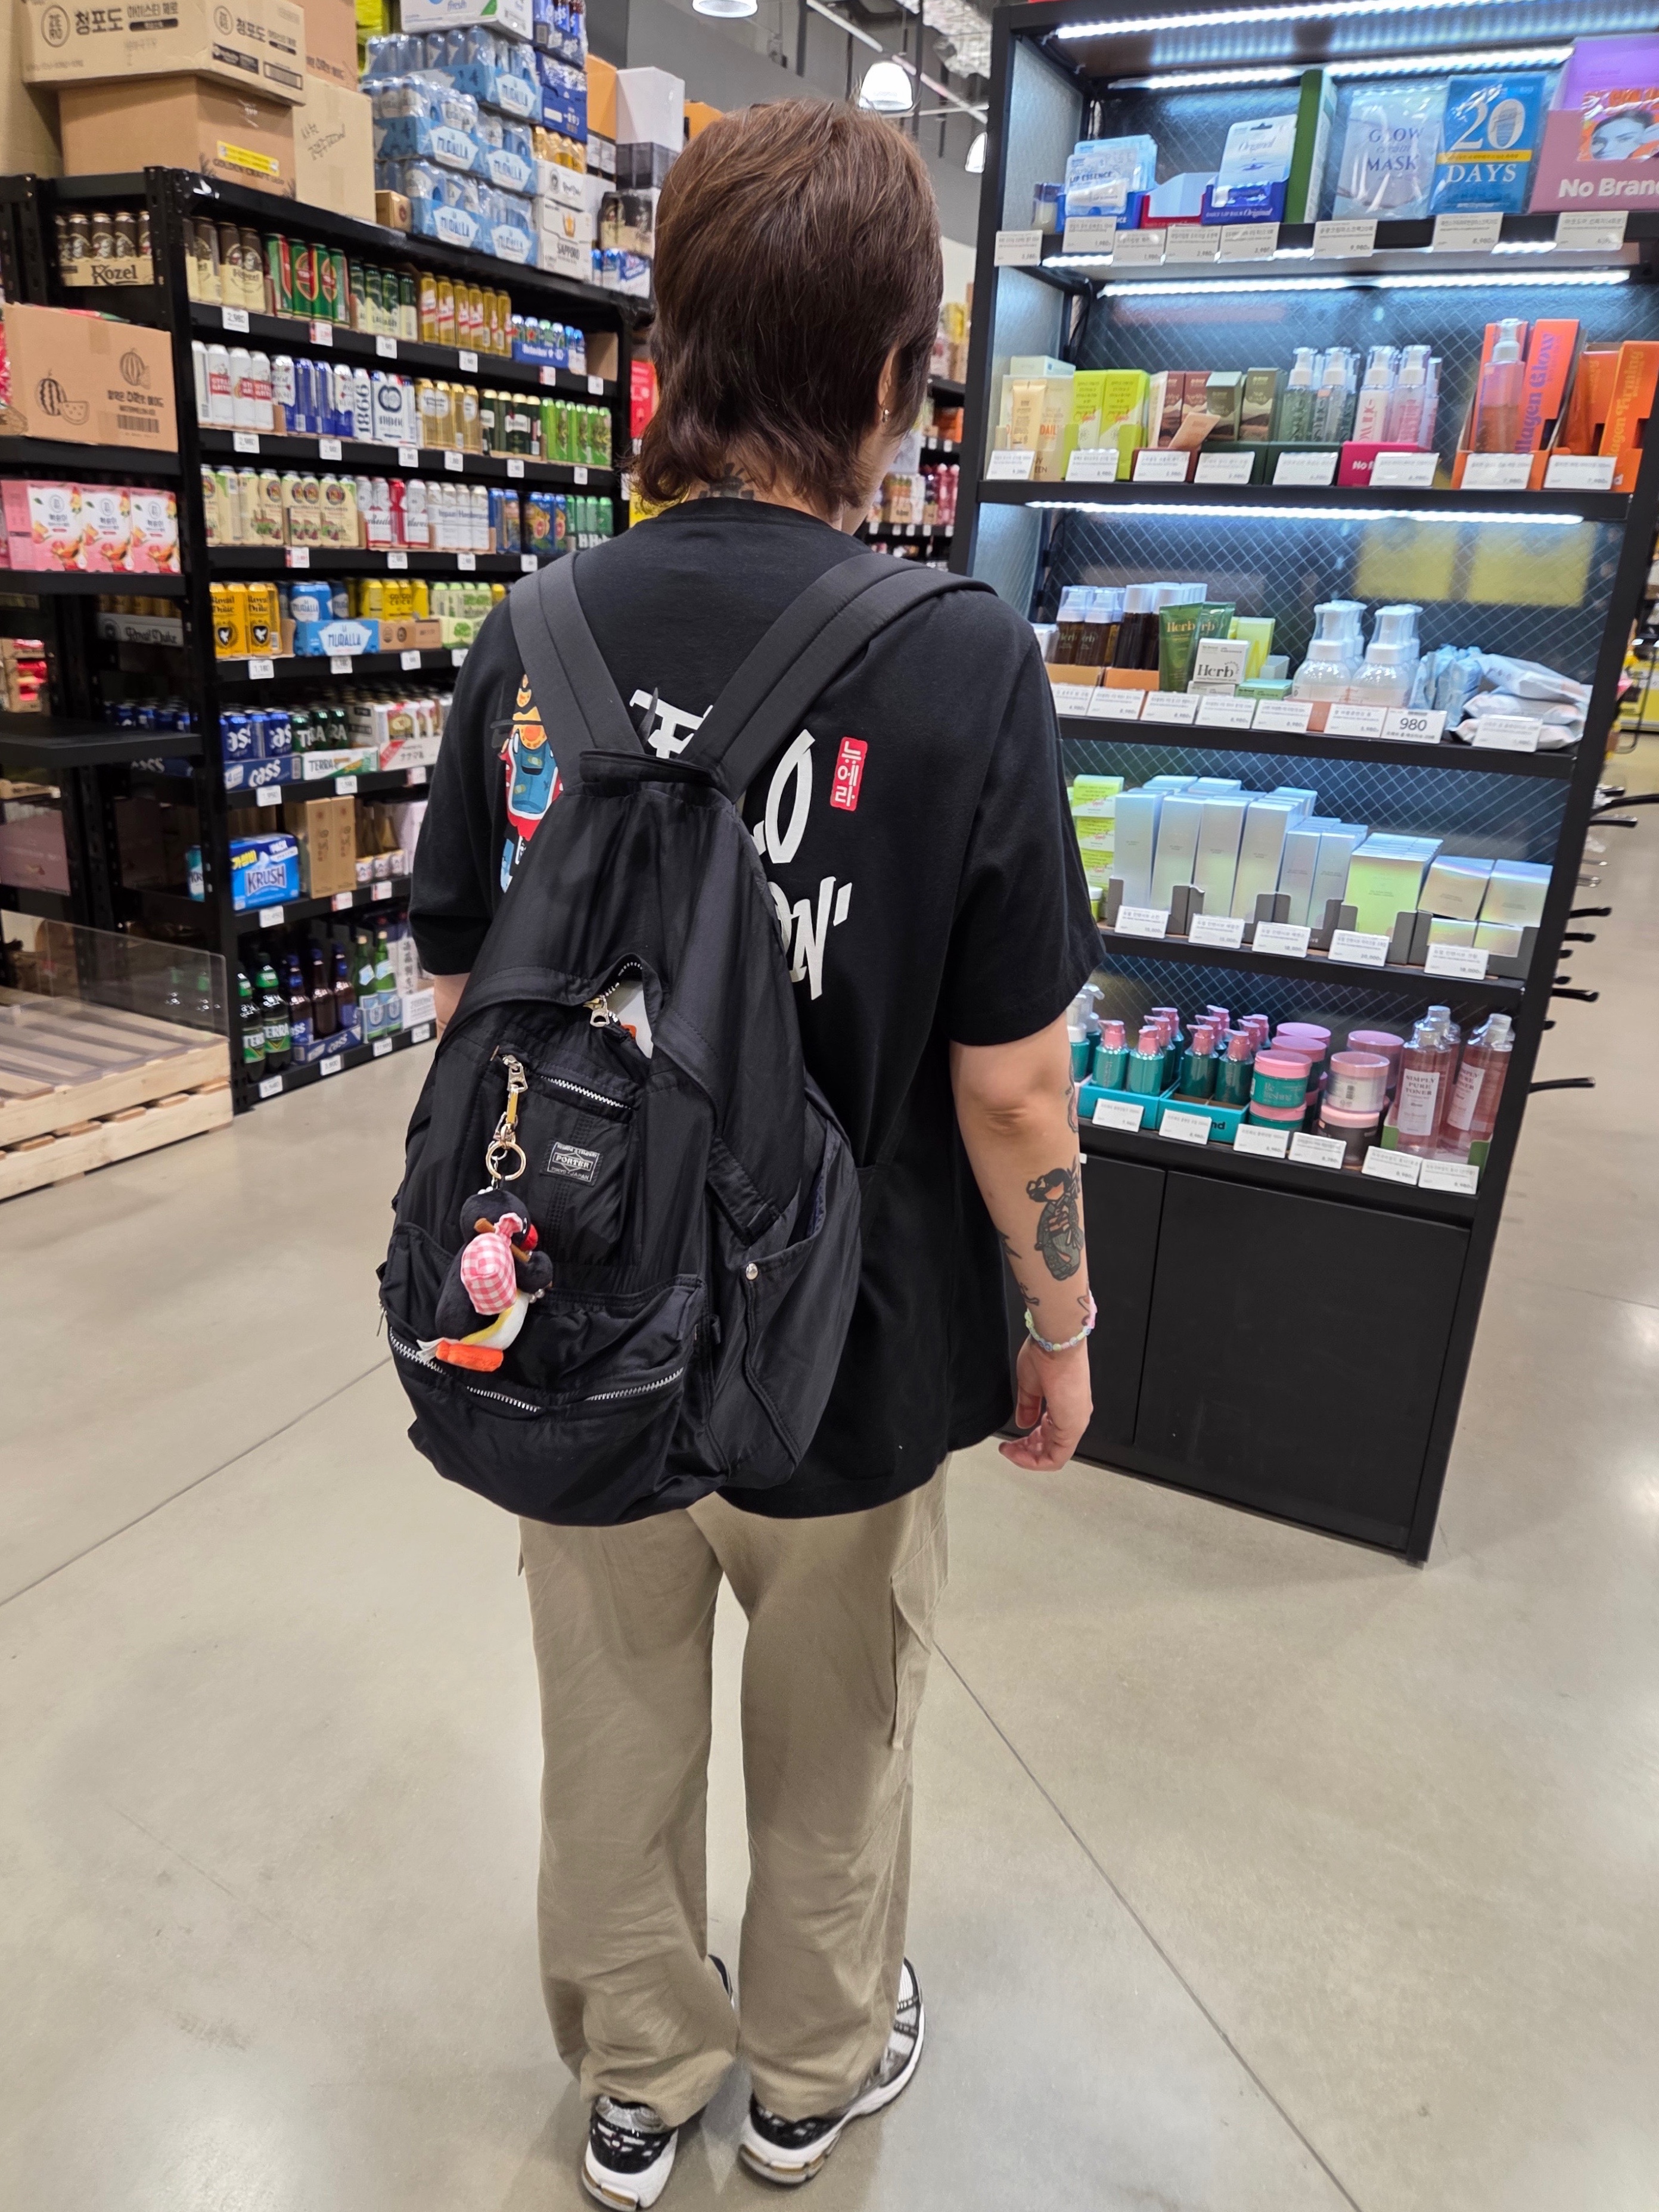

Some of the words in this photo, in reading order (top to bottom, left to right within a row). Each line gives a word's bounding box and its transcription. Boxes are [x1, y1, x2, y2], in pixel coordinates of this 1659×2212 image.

[74, 8, 123, 35] 청포도
[1447, 98, 1526, 150] 20
[1366, 155, 1419, 172] MASK
[1447, 164, 1517, 182] DAYS
[1558, 179, 1594, 197] No
[91, 265, 139, 286] Kozel
[1528, 333, 1555, 389] Glow
[1514, 391, 1543, 453] llagen
[1167, 620, 1195, 633] Herb
[328, 633, 361, 647] MURALLA
[1197, 663, 1234, 678] Herb
[1399, 717, 1428, 732] 980
[309, 759, 334, 772] TERRA
[835, 741, 862, 807] 뉴에라
[248, 866, 285, 893] KRUSH
[1406, 1074, 1436, 1084] SIMPLY
[1405, 1088, 1432, 1096] TONER
[555, 1154, 589, 1169] PORTER
[570, 1172, 589, 1180] JAPAN
